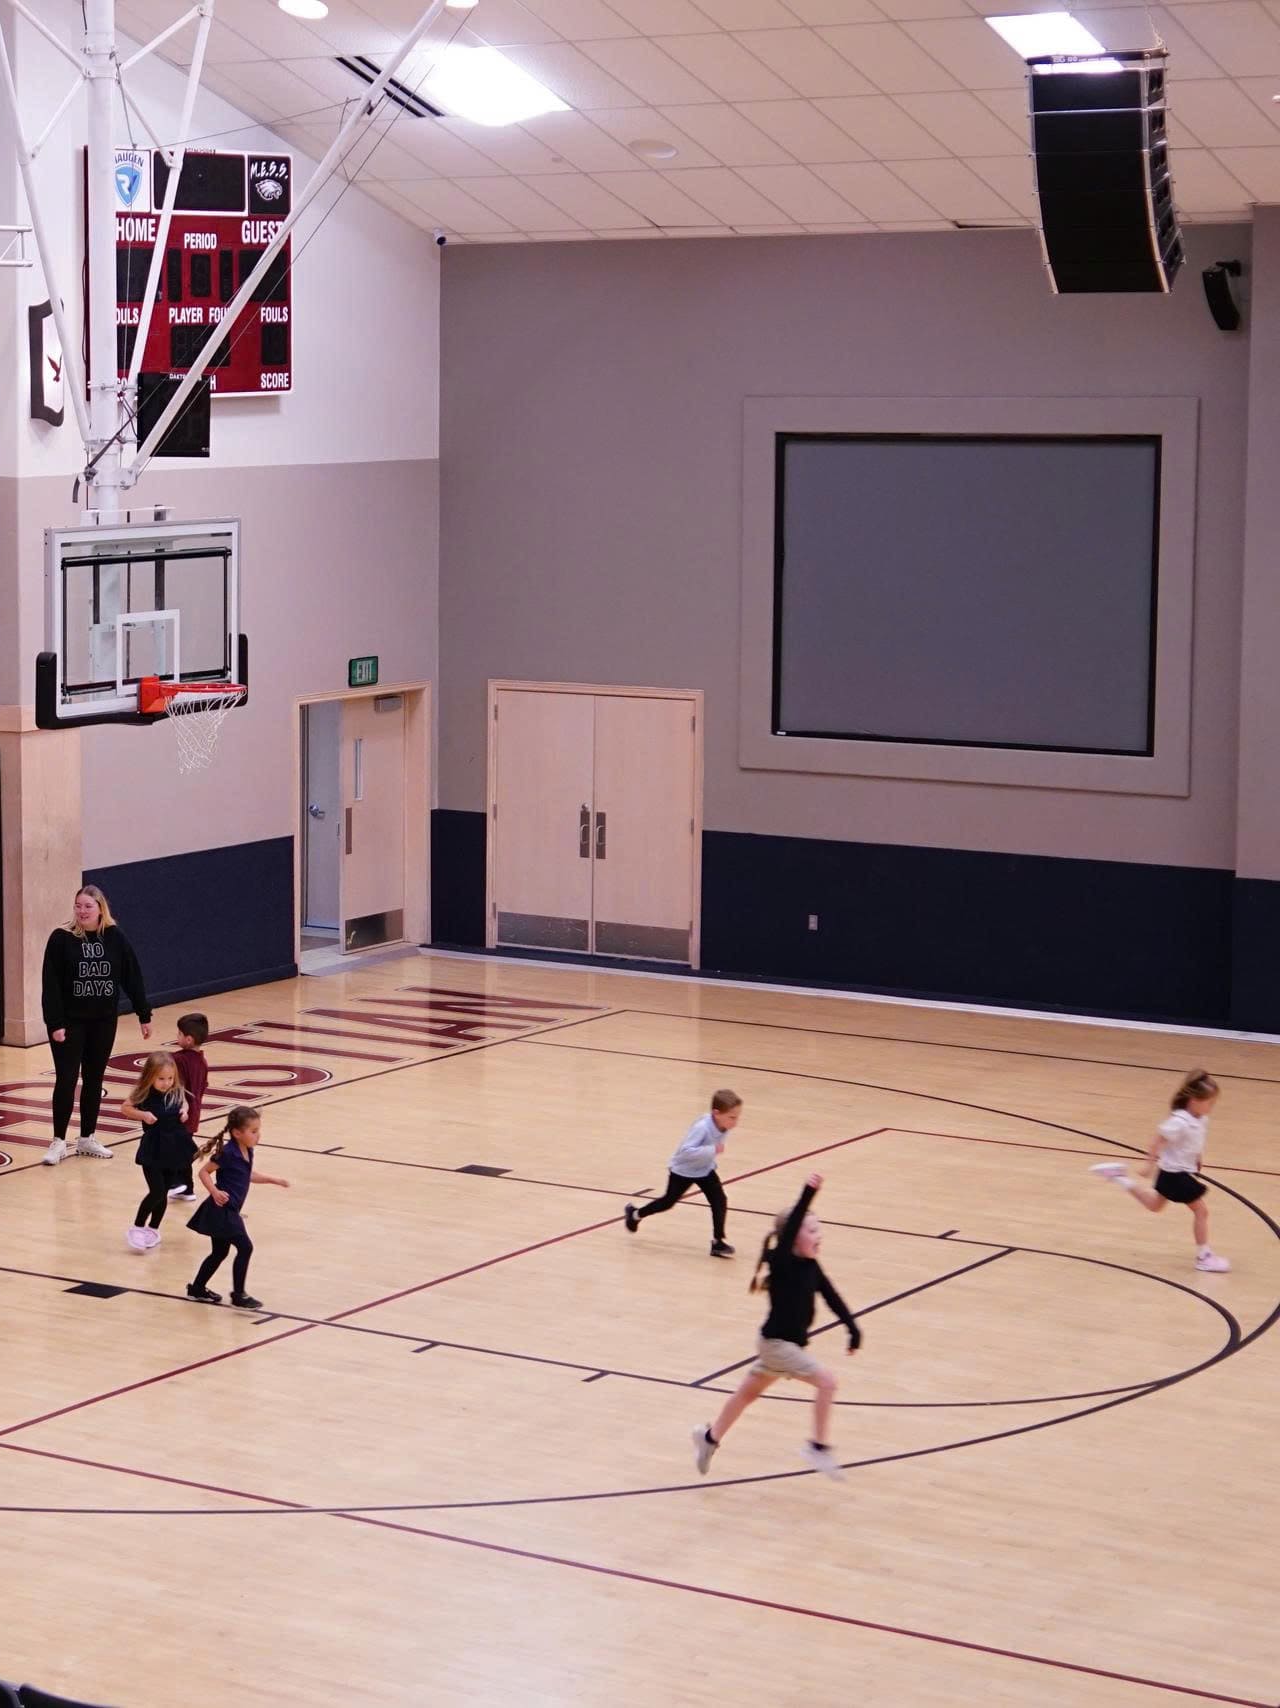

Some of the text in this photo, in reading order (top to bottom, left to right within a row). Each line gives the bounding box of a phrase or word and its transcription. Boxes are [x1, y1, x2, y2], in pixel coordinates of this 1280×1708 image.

[116, 217, 157, 242] HOME
[184, 233, 218, 249] PERIOD
[116, 307, 139, 324] OULS
[169, 307, 230, 323] PLAYER FOU
[261, 307, 289, 322] FOULS
[261, 373, 289, 389] SCORE
[356, 660, 373, 683] EXIT
[82, 942, 104, 958] NO
[79, 961, 111, 977] BAD
[73, 980, 114, 996] DAYS
